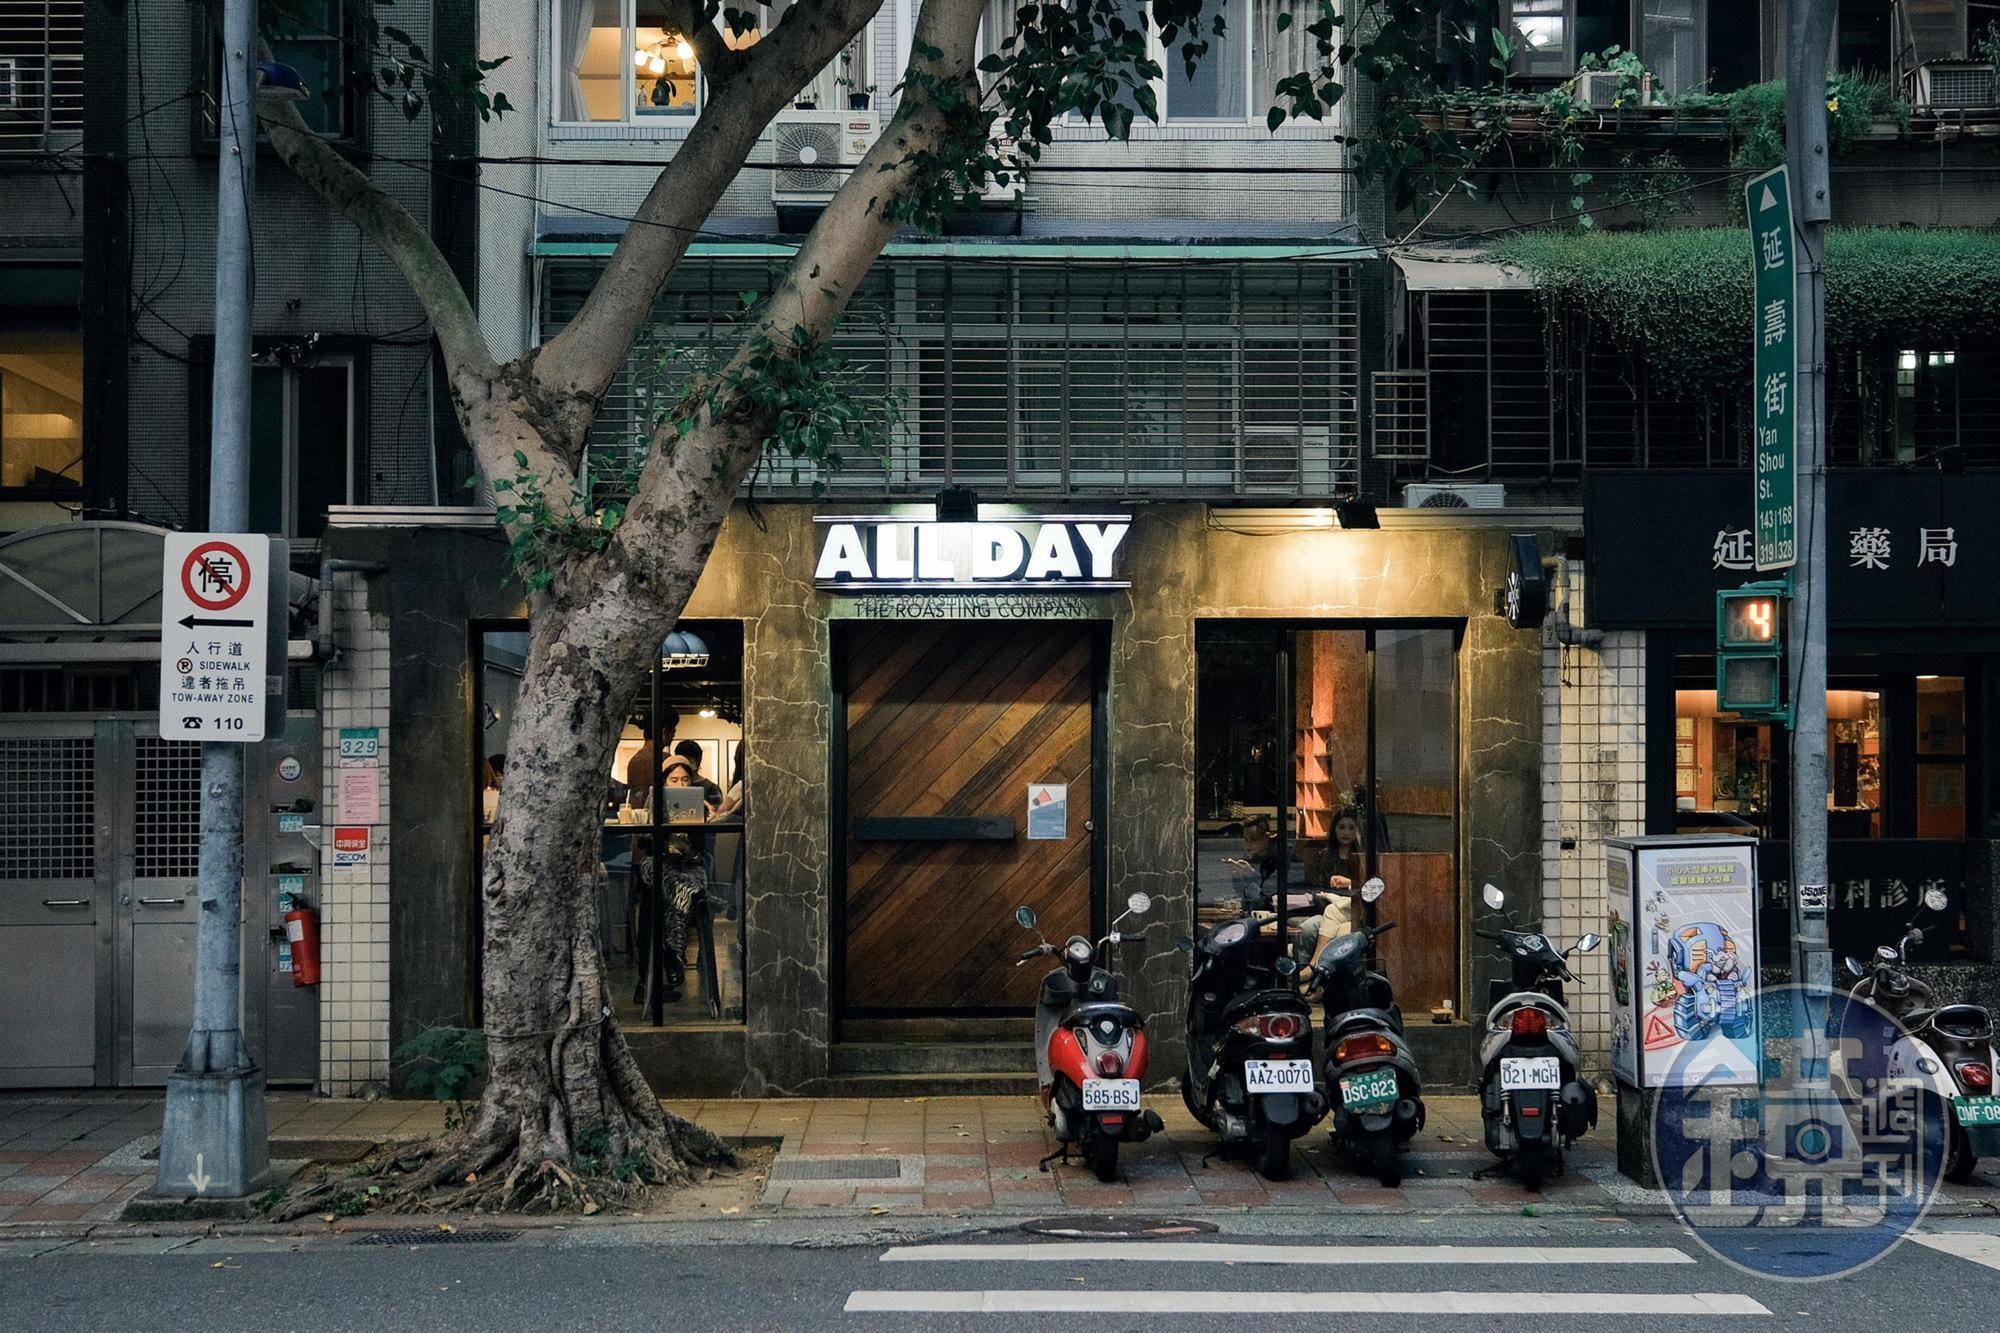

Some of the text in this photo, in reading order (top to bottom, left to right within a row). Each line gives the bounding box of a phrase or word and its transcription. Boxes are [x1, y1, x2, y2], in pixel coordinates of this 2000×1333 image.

[1762, 226, 1787, 418] 延壽街
[1759, 426, 1777, 446] Yan
[1759, 453, 1785, 473] Shou
[1759, 479, 1773, 499] St.
[1760, 506, 1792, 529] 143 168
[814, 523, 1130, 579] ALL DAY
[1712, 526, 1958, 570] 延藥局
[1760, 539, 1792, 563] 319 328
[198, 557, 233, 593] 停
[854, 602, 1091, 618] THE ROASTING COMPANY
[1749, 602, 1771, 639] 4
[186, 641, 243, 656] 人行道
[200, 661, 251, 671] SIDEWALK
[181, 675, 245, 690] 違者拖吊
[172, 692, 254, 704] TOW-AWAY ZONE
[214, 717, 243, 730] 110
[342, 741, 376, 754] 329
[336, 853, 366, 861] SECOM
